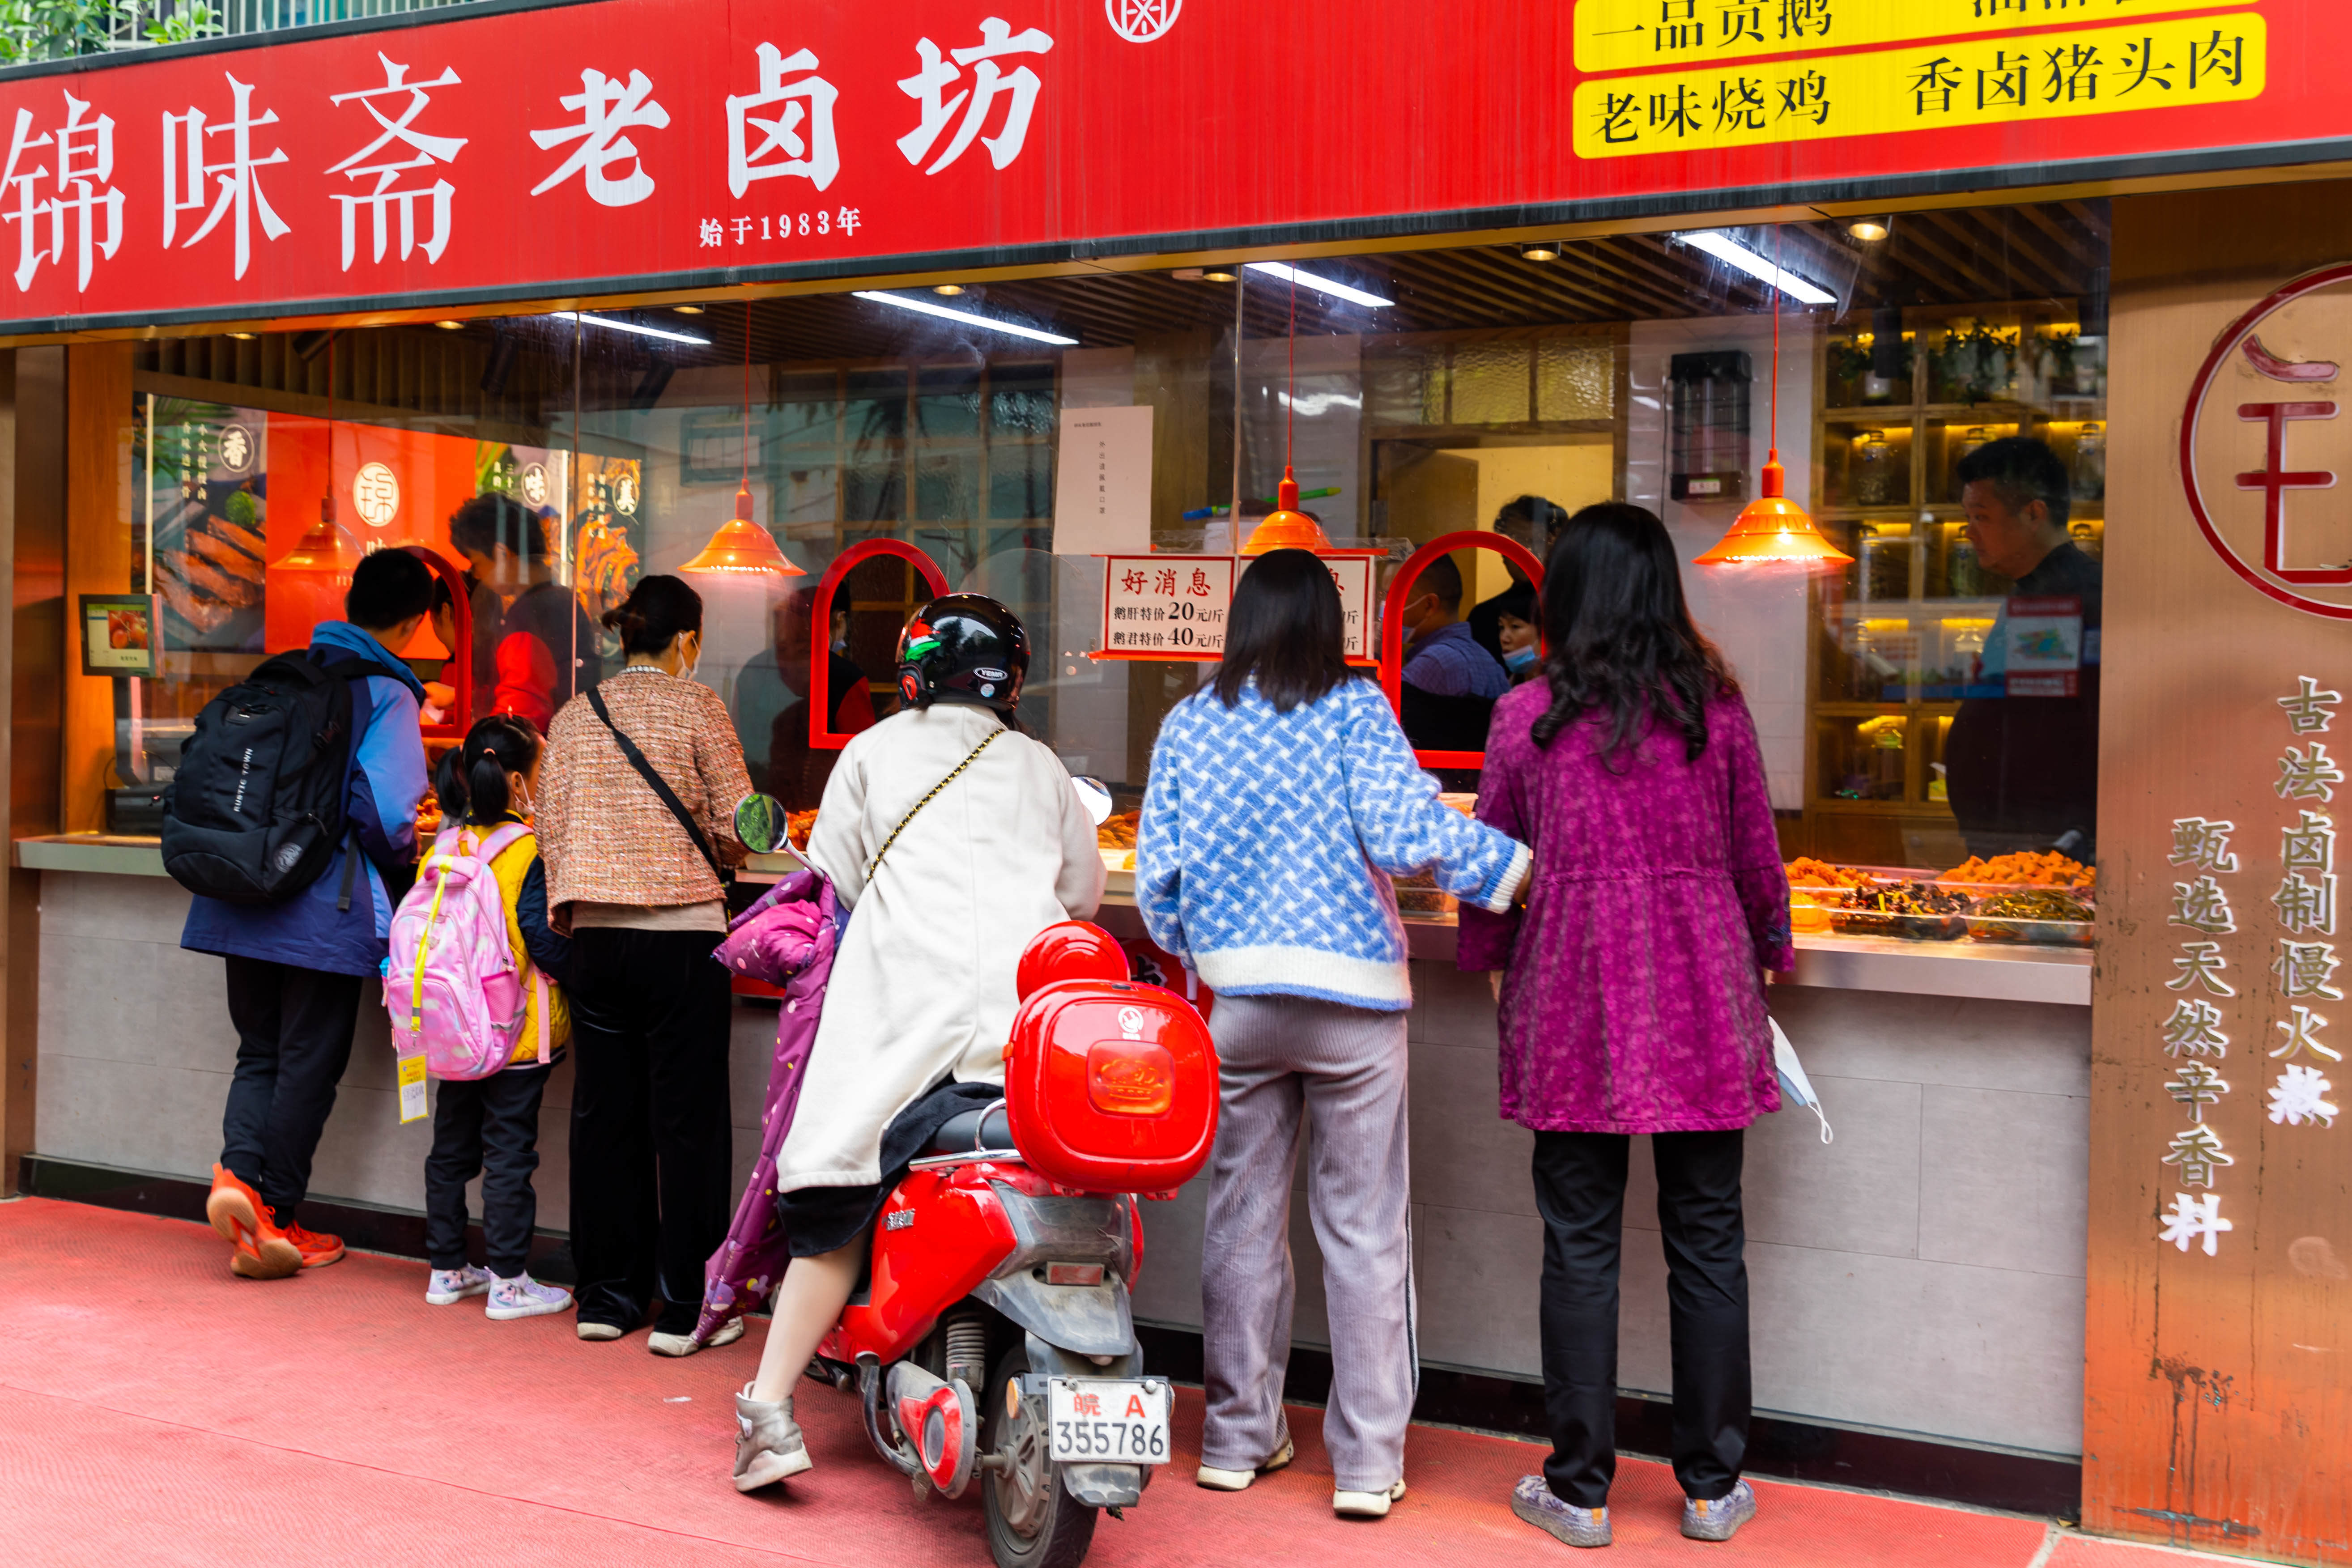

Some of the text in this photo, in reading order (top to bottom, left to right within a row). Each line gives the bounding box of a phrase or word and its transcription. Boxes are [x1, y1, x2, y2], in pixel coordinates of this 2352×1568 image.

[1905, 30, 2245, 115] 香卤猪头肉
[1590, 70, 1831, 144] 老味烧鸡
[0, 16, 1054, 293] 锦味斋 老卤坊
[699, 206, 862, 248] 始于1983年
[224, 430, 247, 467] 香
[525, 467, 545, 501] 味
[1121, 567, 1211, 597] 好消息
[1114, 602, 1225, 623] 鹅肝特价20元/斤
[242, 748, 254, 775] TOWN
[2158, 816, 2239, 1256] 甄选天然辛香料
[1074, 1393, 1146, 1418] 皖 A
[1056, 1421, 1164, 1456] 355786
